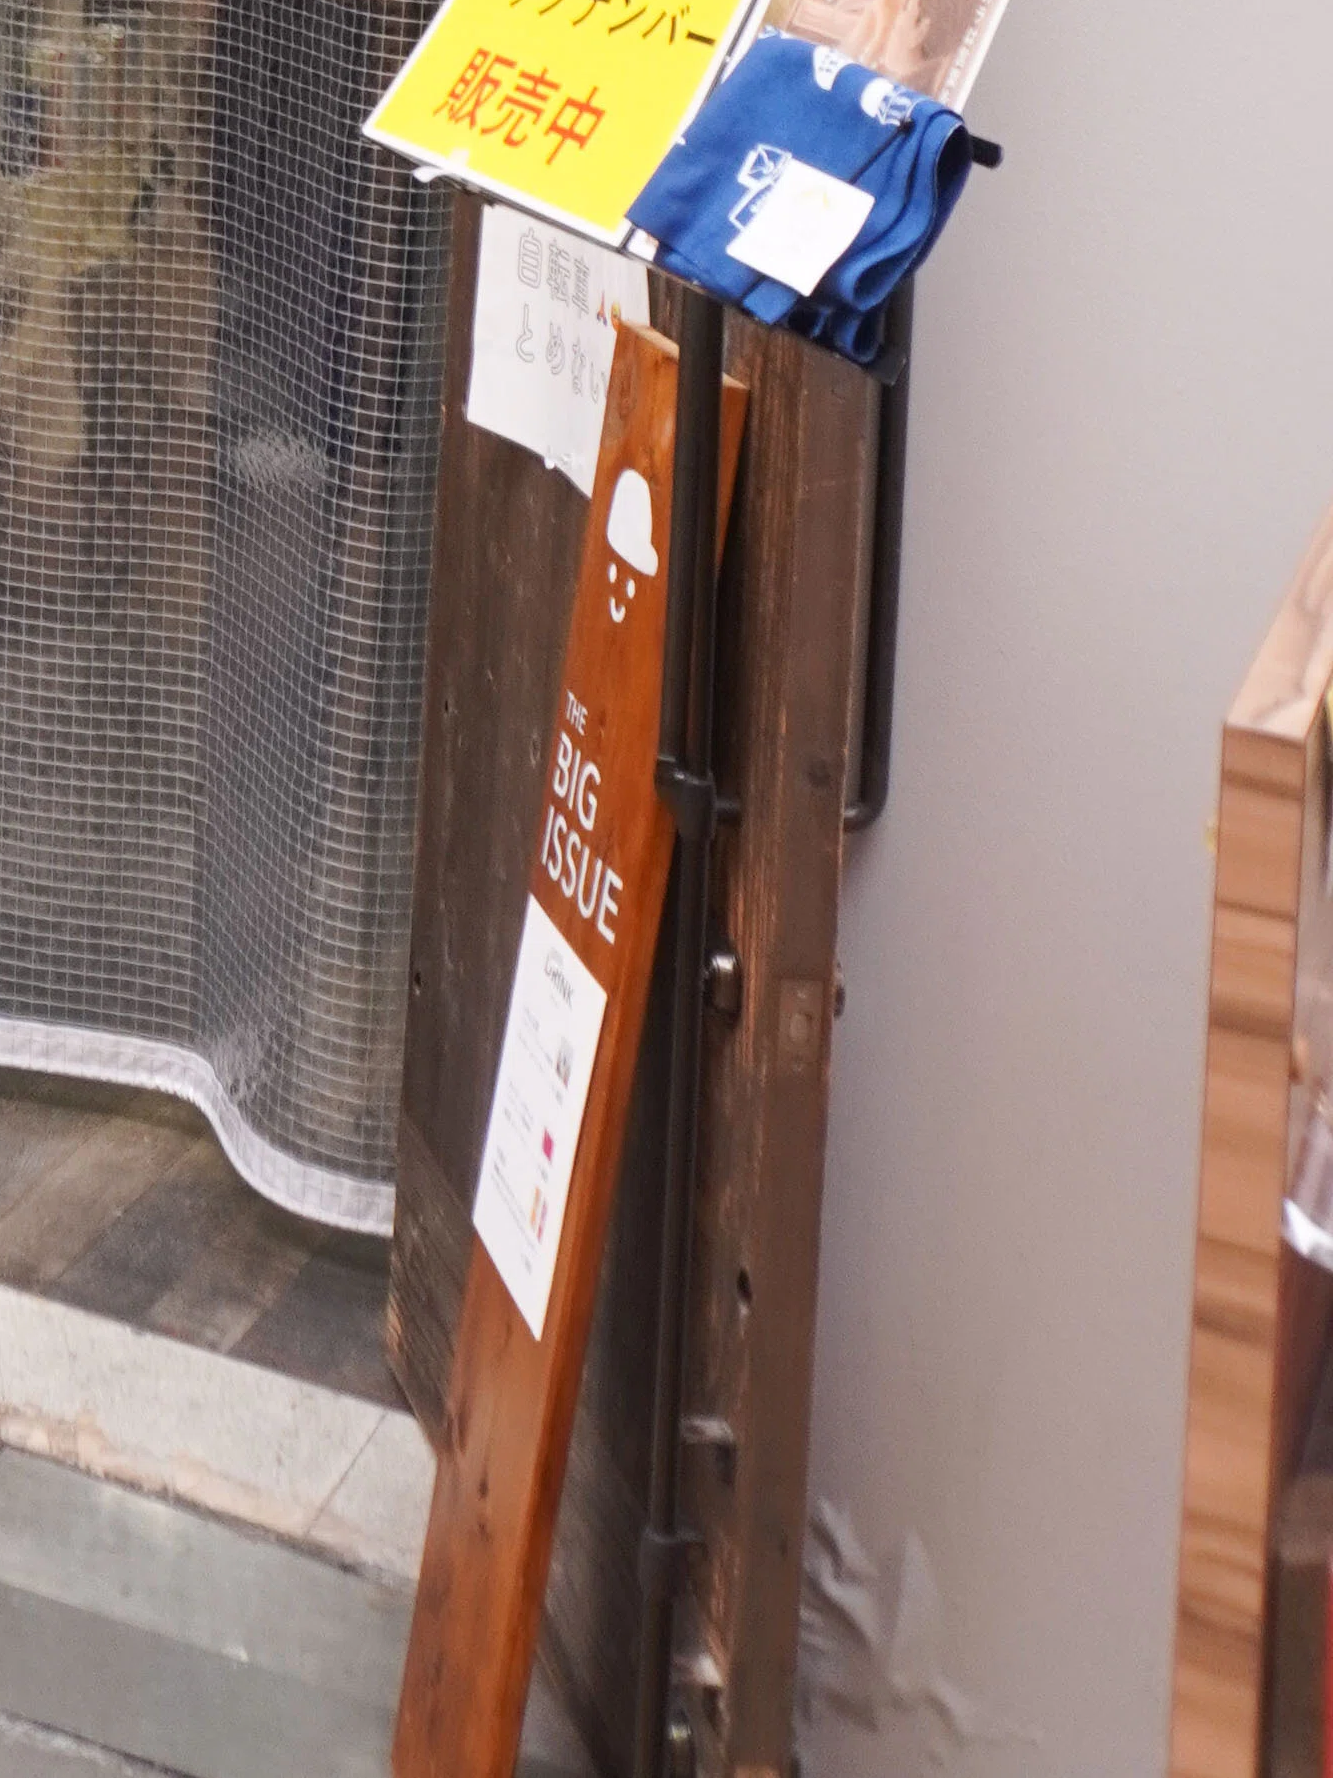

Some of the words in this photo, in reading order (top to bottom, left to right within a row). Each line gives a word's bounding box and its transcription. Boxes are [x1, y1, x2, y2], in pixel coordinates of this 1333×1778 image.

[434, 46, 608, 167] 販売中
[565, 688, 588, 736] THE
[553, 731, 601, 832] BIG
[541, 804, 623, 946] ISSUE
